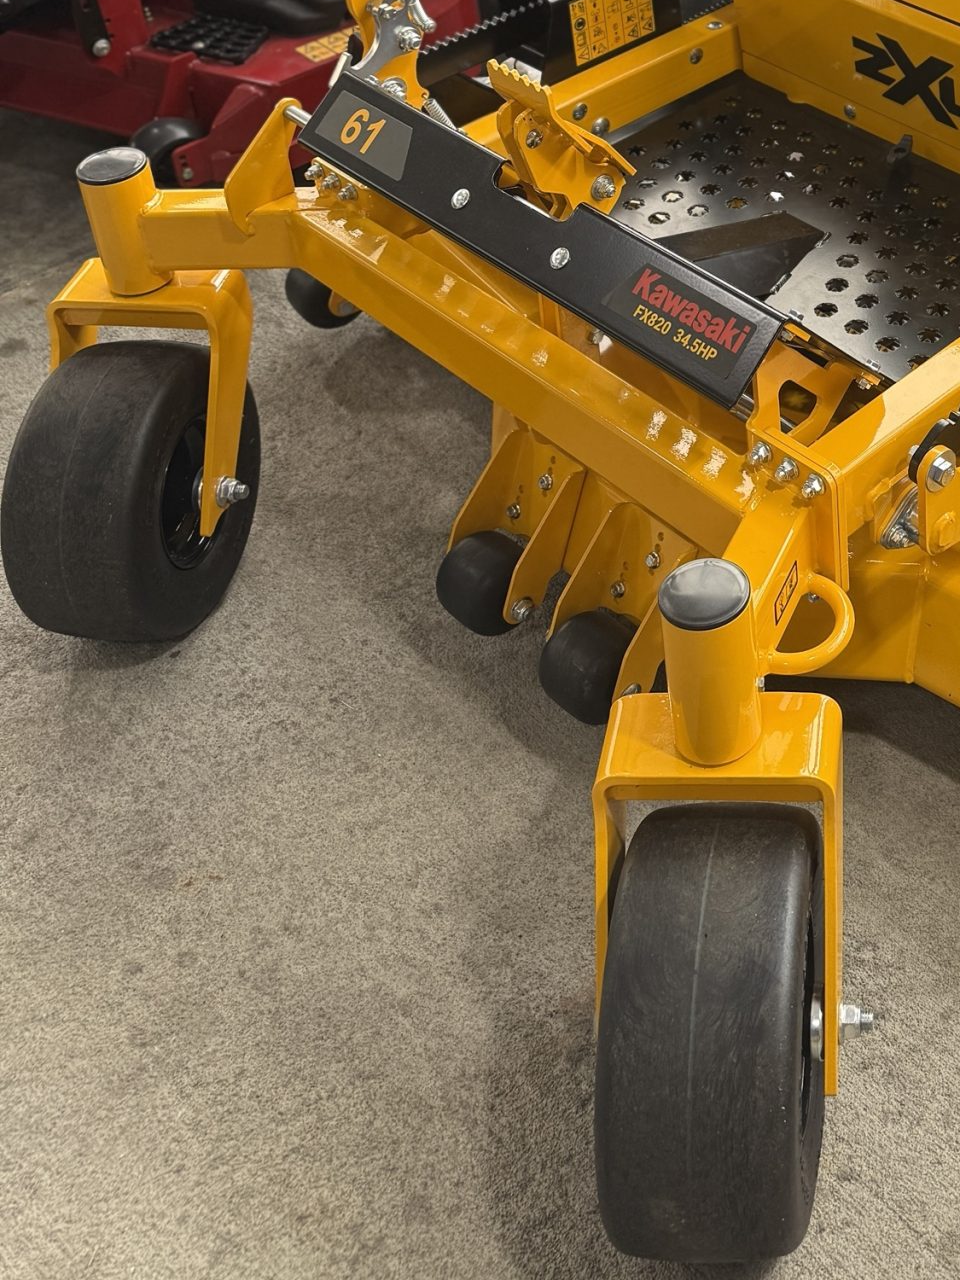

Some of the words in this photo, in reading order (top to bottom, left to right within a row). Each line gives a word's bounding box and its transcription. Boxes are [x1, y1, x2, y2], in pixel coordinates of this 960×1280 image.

[340, 107, 387, 155] 61
[631, 267, 751, 354] Kawasaki
[632, 304, 673, 335] FX820
[673, 328, 718, 361] 34.5HP
